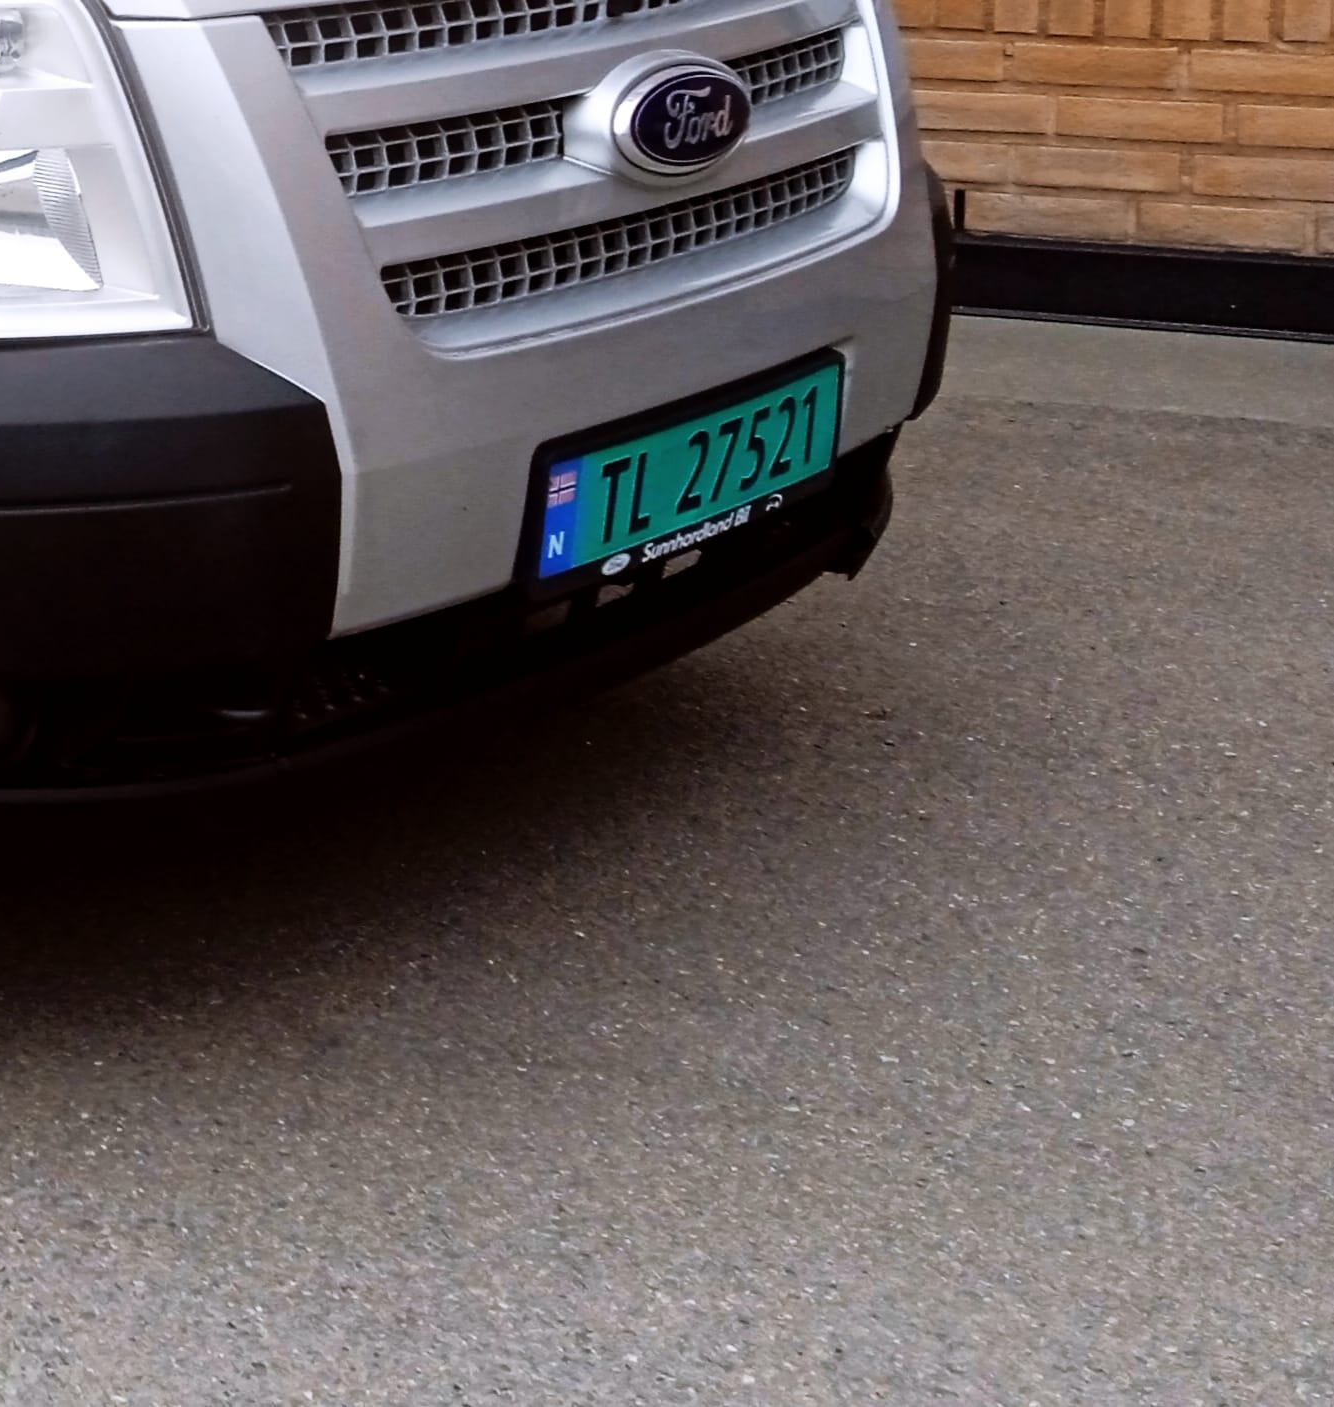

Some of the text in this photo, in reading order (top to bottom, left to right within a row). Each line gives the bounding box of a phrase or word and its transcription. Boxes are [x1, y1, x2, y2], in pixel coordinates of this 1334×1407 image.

[662, 85, 734, 150] Ford
[601, 385, 819, 545] TL 27521
[547, 530, 566, 559] N
[641, 510, 735, 563] Sunnhordland
